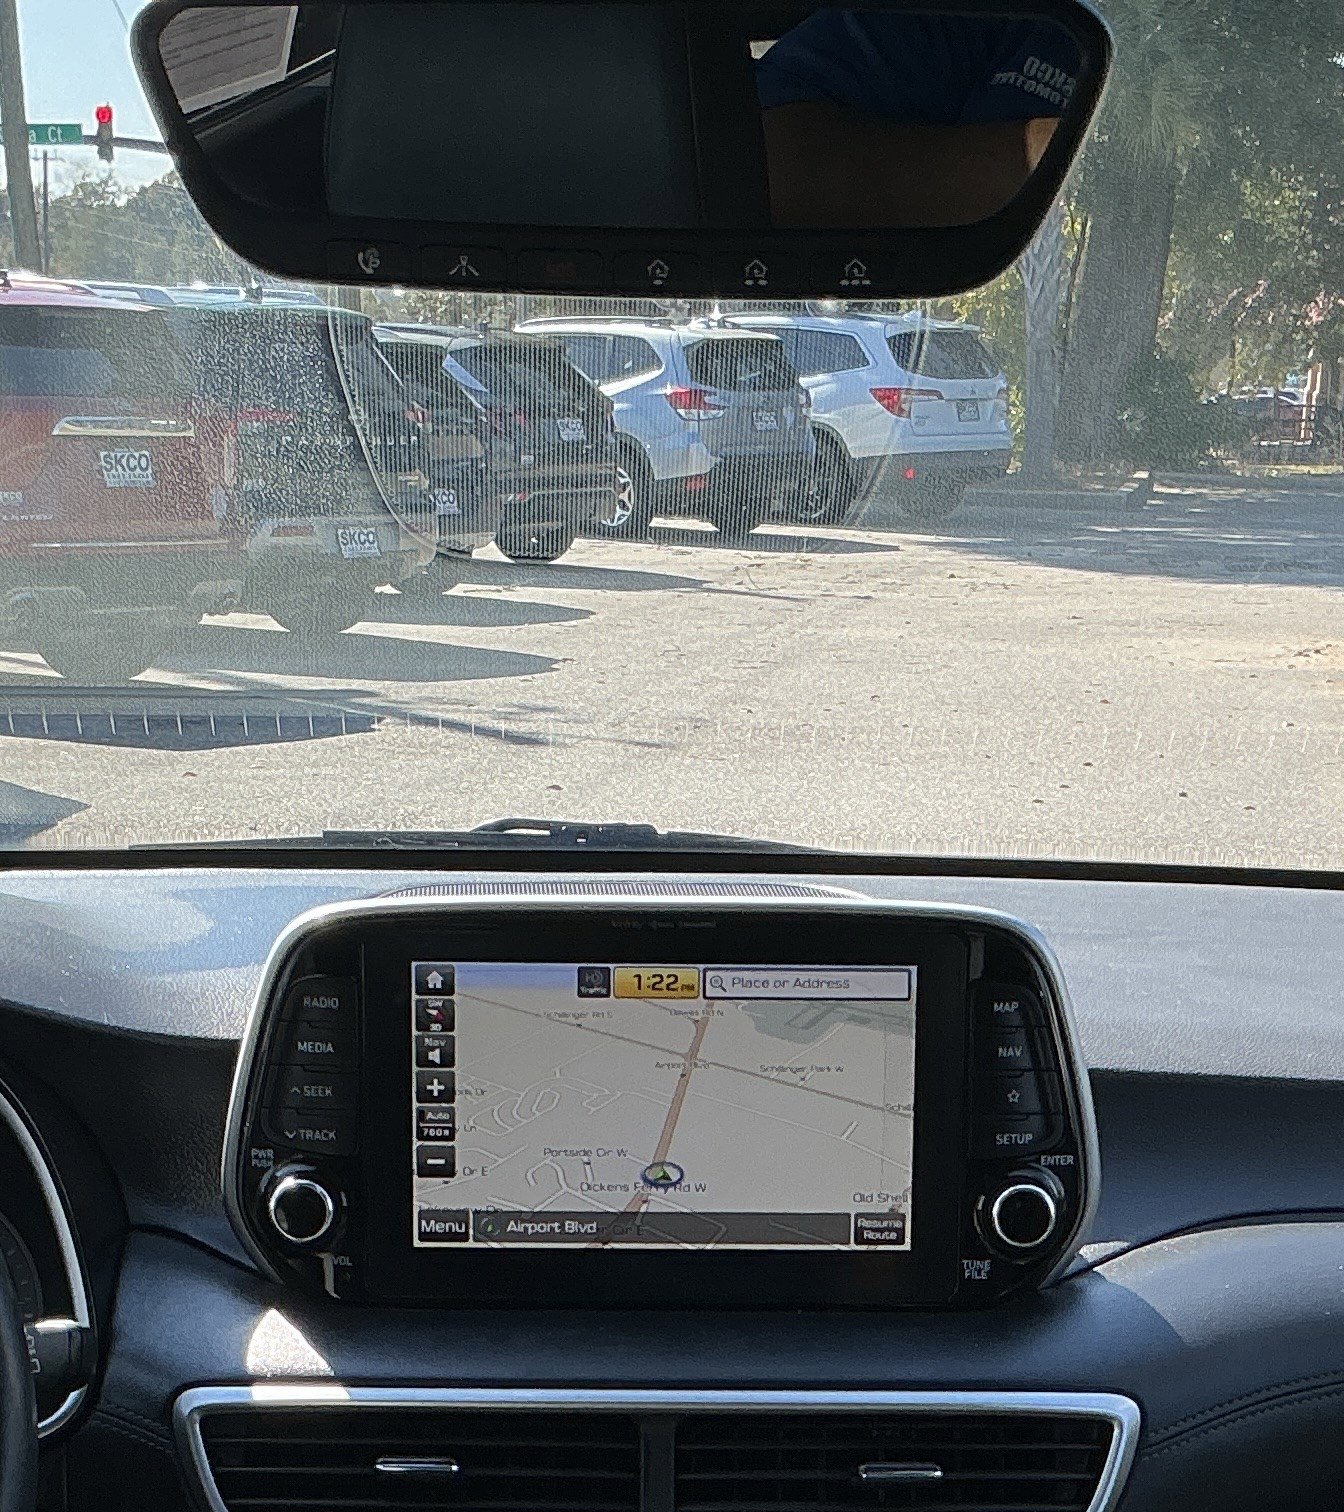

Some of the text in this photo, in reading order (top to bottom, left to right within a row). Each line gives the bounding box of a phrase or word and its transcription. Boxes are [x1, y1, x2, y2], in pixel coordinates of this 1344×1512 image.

[47, 126, 64, 143] Ct
[102, 453, 150, 473] SKCO
[340, 530, 376, 547] SKCO
[632, 973, 680, 992] 1:22
[731, 977, 851, 989] Place or Address
[303, 997, 339, 1009] RADIO
[993, 1002, 1019, 1012] MAP
[297, 1042, 334, 1053] MEDIA
[424, 1037, 446, 1047] Nav
[998, 1046, 1022, 1057] NAV
[303, 1085, 333, 1097] SEEK
[300, 1129, 337, 1141] TRACK
[995, 1133, 1033, 1145] SETUP
[251, 1149, 274, 1159] PWR
[544, 1148, 629, 1158] Portside Dr W
[251, 1159, 274, 1168] PUSH
[1040, 1155, 1074, 1166] ENTER
[462, 1165, 489, 1176] Dr E
[580, 1182, 630, 1192] Dickens
[673, 1183, 692, 1192] Rd
[694, 1183, 707, 1192] W
[853, 1192, 909, 1203] Old Shell
[421, 1220, 467, 1233] Menu
[506, 1220, 598, 1235] Airport Blvd
[858, 1218, 903, 1228] Resume
[863, 1230, 897, 1240] Route
[332, 1255, 353, 1266] VOL
[962, 1260, 991, 1270] TUNE
[964, 1269, 988, 1280] FILE
